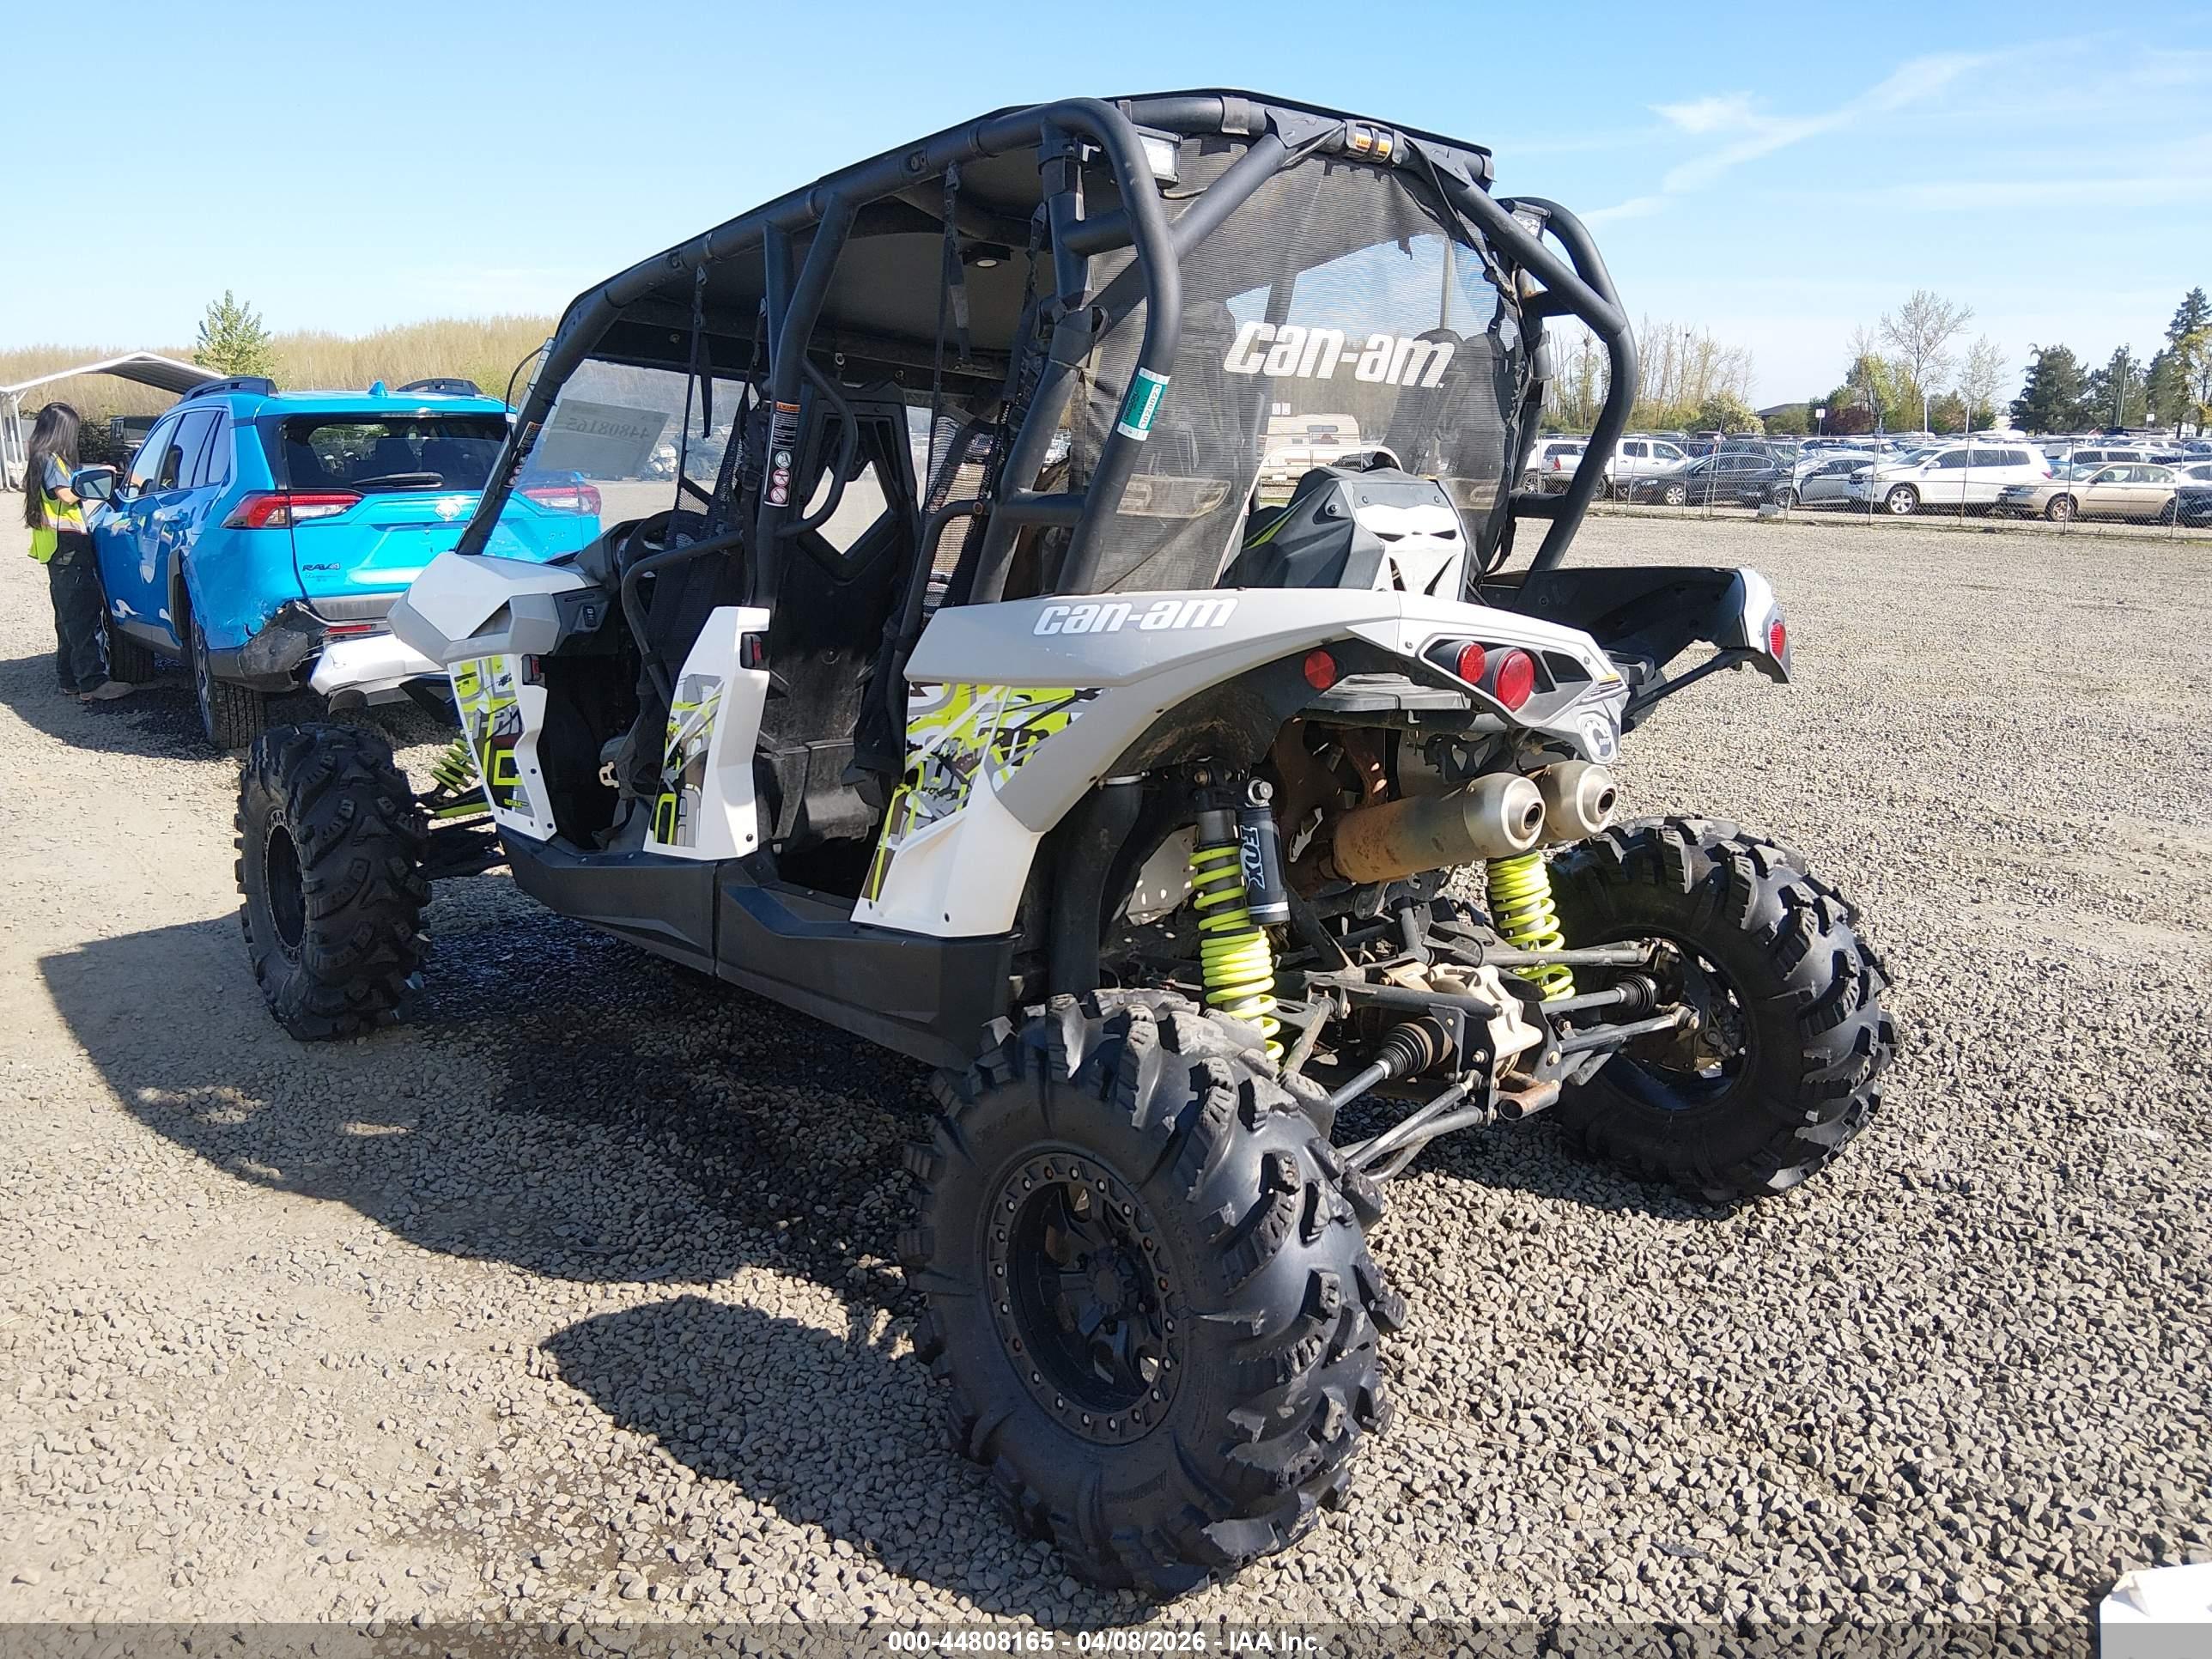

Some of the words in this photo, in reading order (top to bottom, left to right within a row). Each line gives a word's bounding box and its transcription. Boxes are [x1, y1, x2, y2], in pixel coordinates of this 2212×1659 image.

[1223, 320, 1455, 389] can-am
[1033, 598, 1238, 635] can-am
[1239, 824, 1267, 891] FOX
